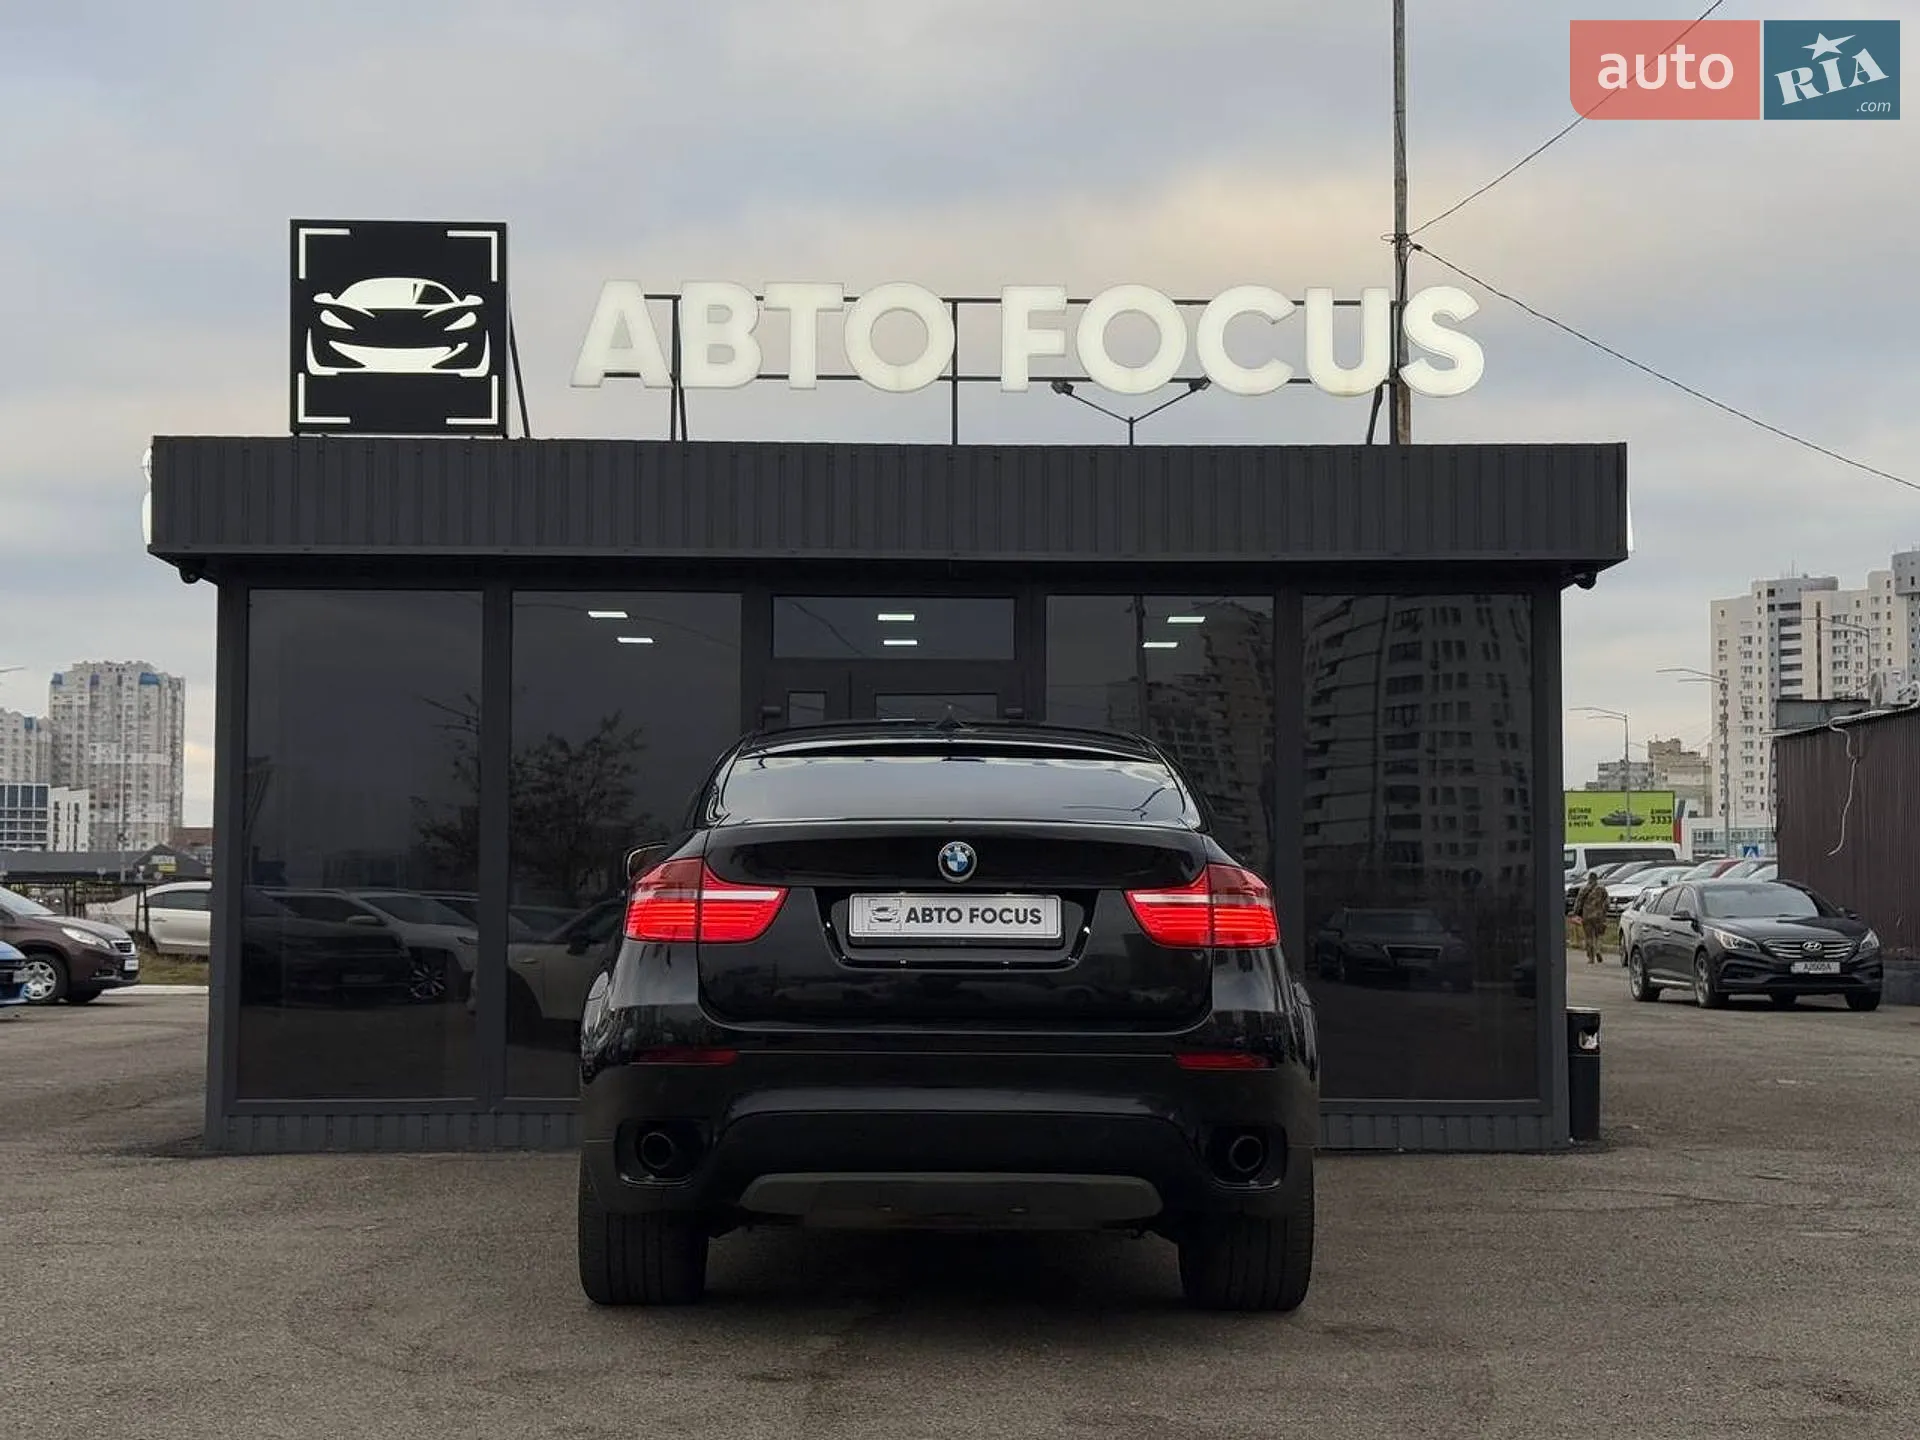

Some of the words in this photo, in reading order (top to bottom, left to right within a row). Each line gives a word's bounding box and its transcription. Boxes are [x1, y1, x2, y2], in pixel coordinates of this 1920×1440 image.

[570, 280, 956, 392] АВТО
[999, 283, 1485, 398] FOCUS
[905, 907, 963, 924] АВТО
[969, 907, 1042, 924] FOCUS
